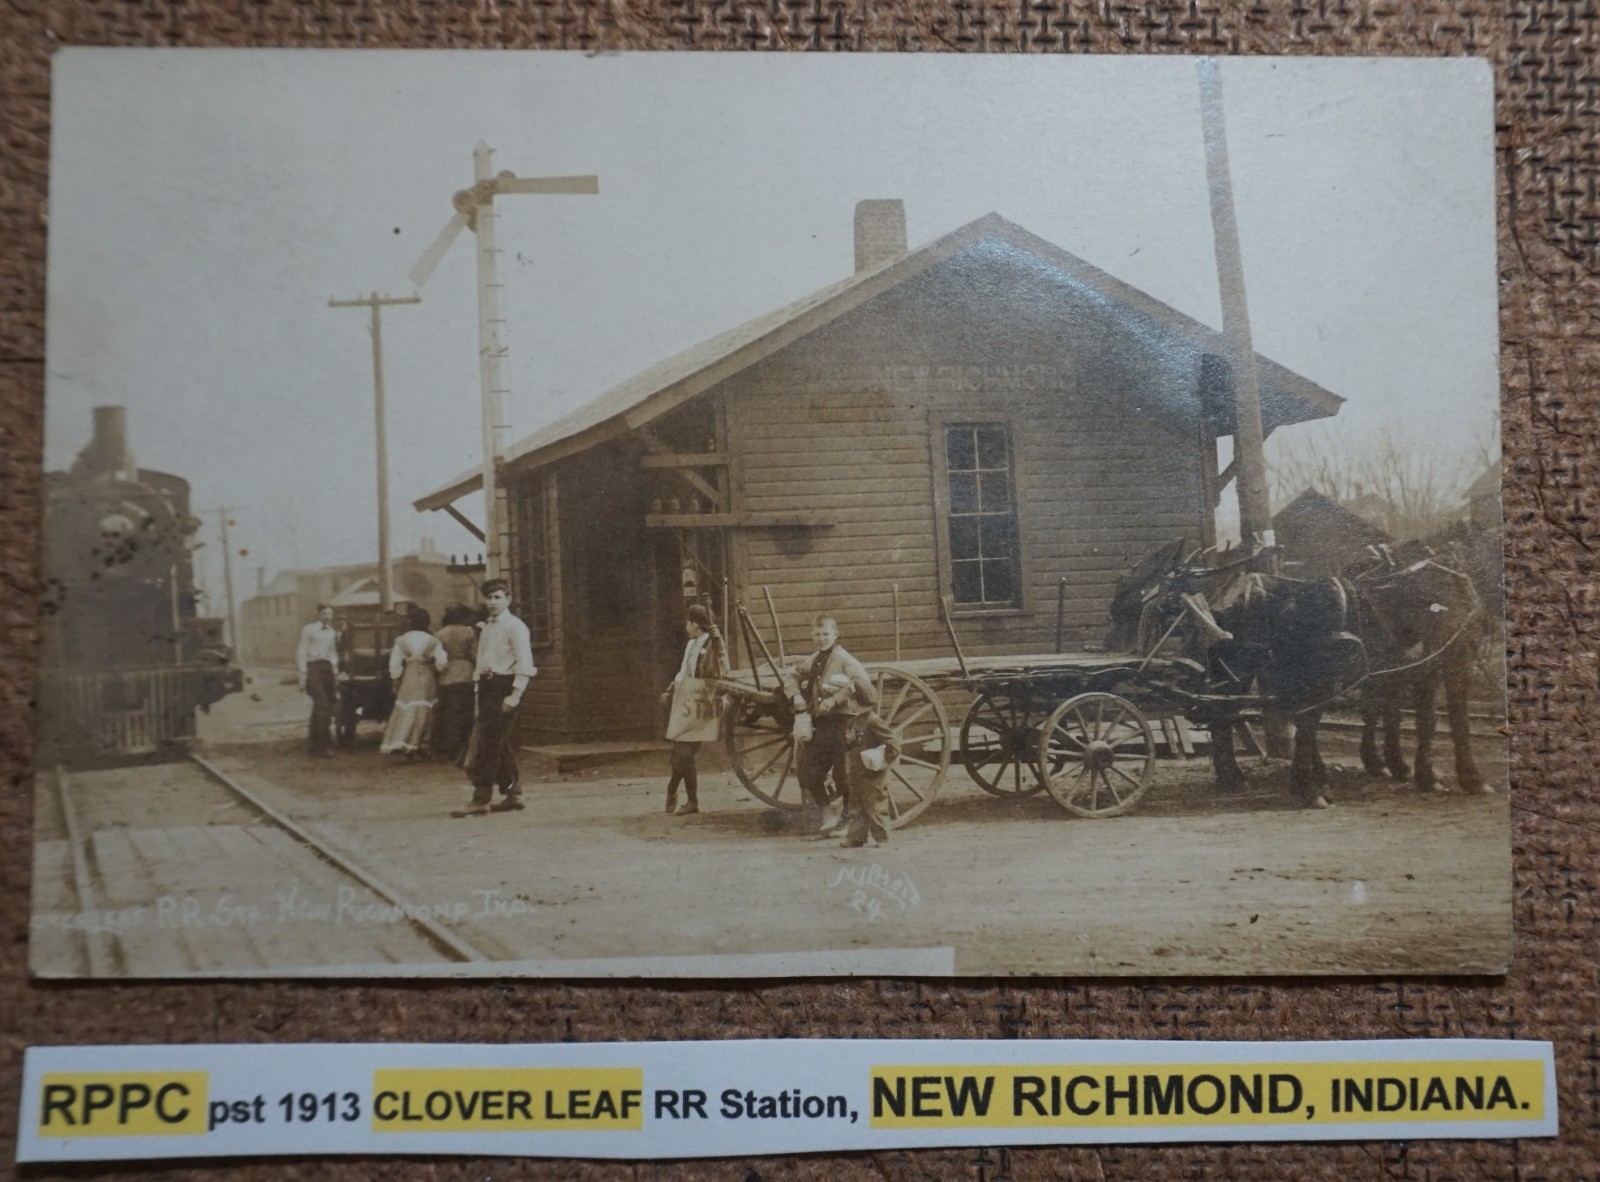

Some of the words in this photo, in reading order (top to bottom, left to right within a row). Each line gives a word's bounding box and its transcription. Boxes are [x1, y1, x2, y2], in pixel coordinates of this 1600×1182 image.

[40, 1081, 191, 1126] RPPC
[208, 1095, 266, 1132] pst
[283, 1092, 362, 1122] 1913
[373, 1090, 533, 1121] CLOVER
[545, 1088, 643, 1120] LEAF
[653, 1089, 708, 1119] RR
[719, 1087, 859, 1122] Station,
[872, 1075, 995, 1118] NEW
[1012, 1073, 1316, 1121] RICHMOND,
[1330, 1075, 1531, 1114] INDIANA.
